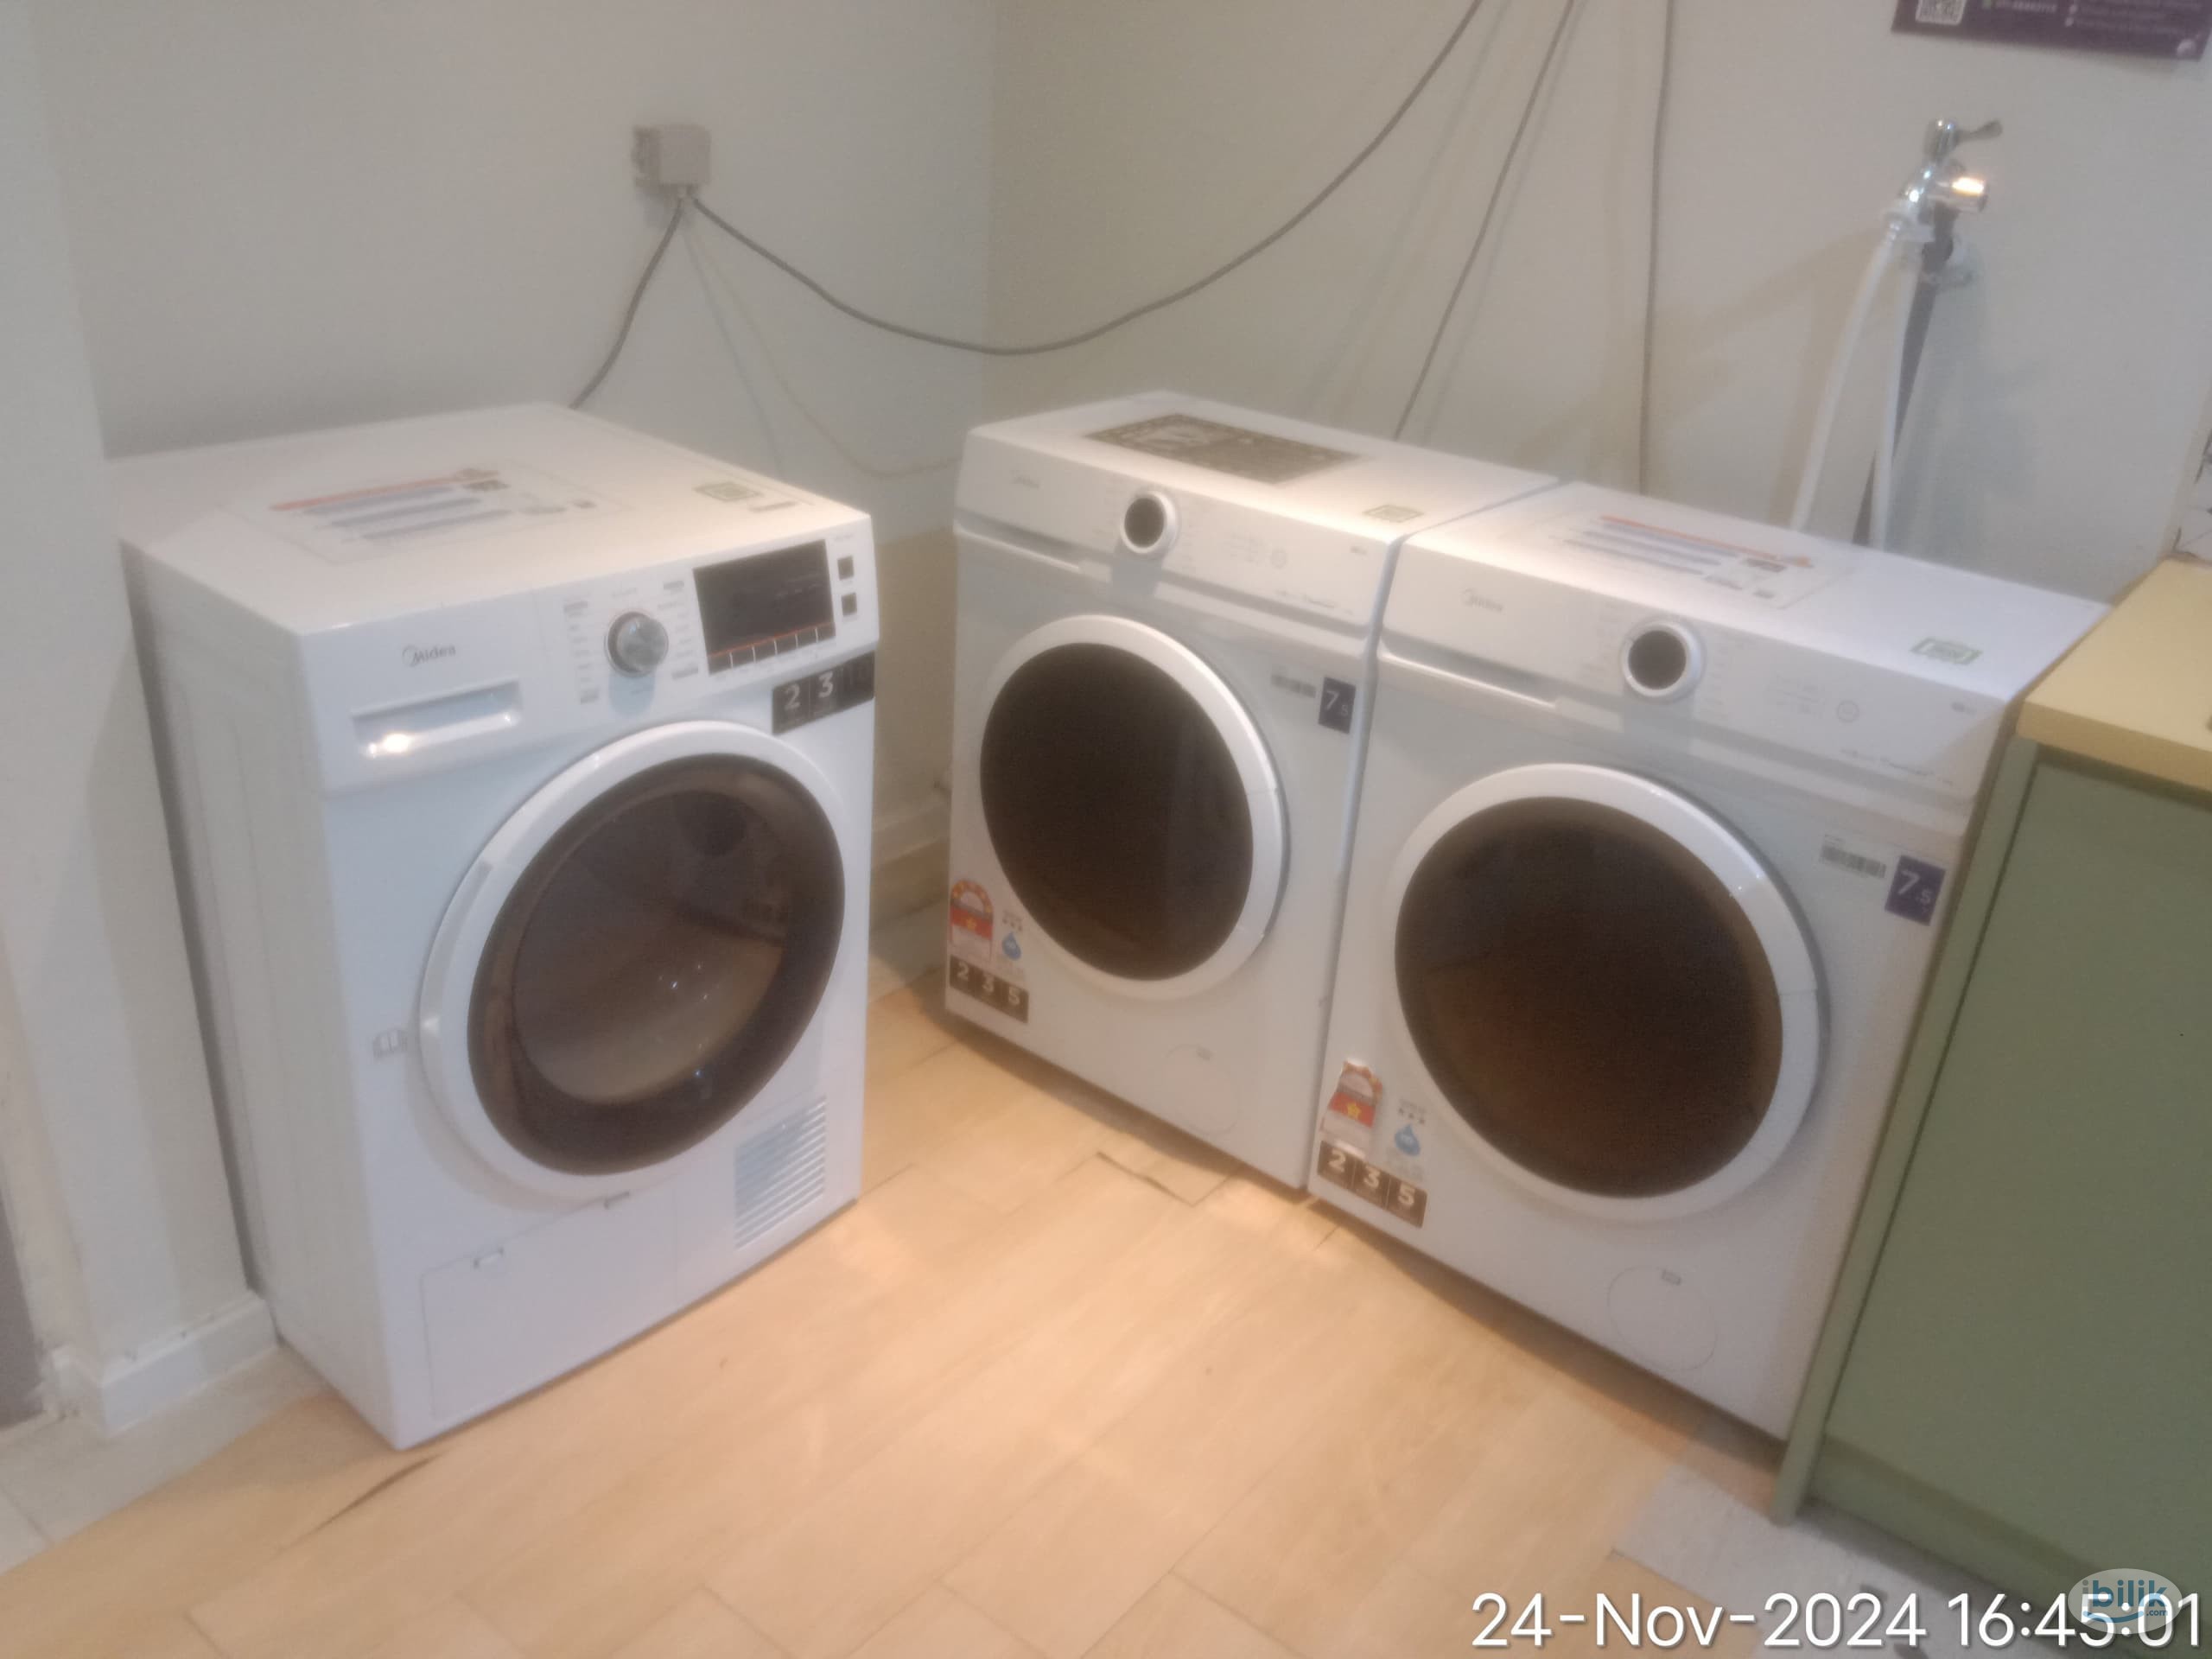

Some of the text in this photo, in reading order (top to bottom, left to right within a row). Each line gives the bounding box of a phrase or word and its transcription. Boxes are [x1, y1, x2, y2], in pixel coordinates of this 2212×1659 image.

[785, 671, 834, 710] 2 3
[957, 961, 969, 981] 2
[1329, 1148, 1415, 1206] 2 3 5
